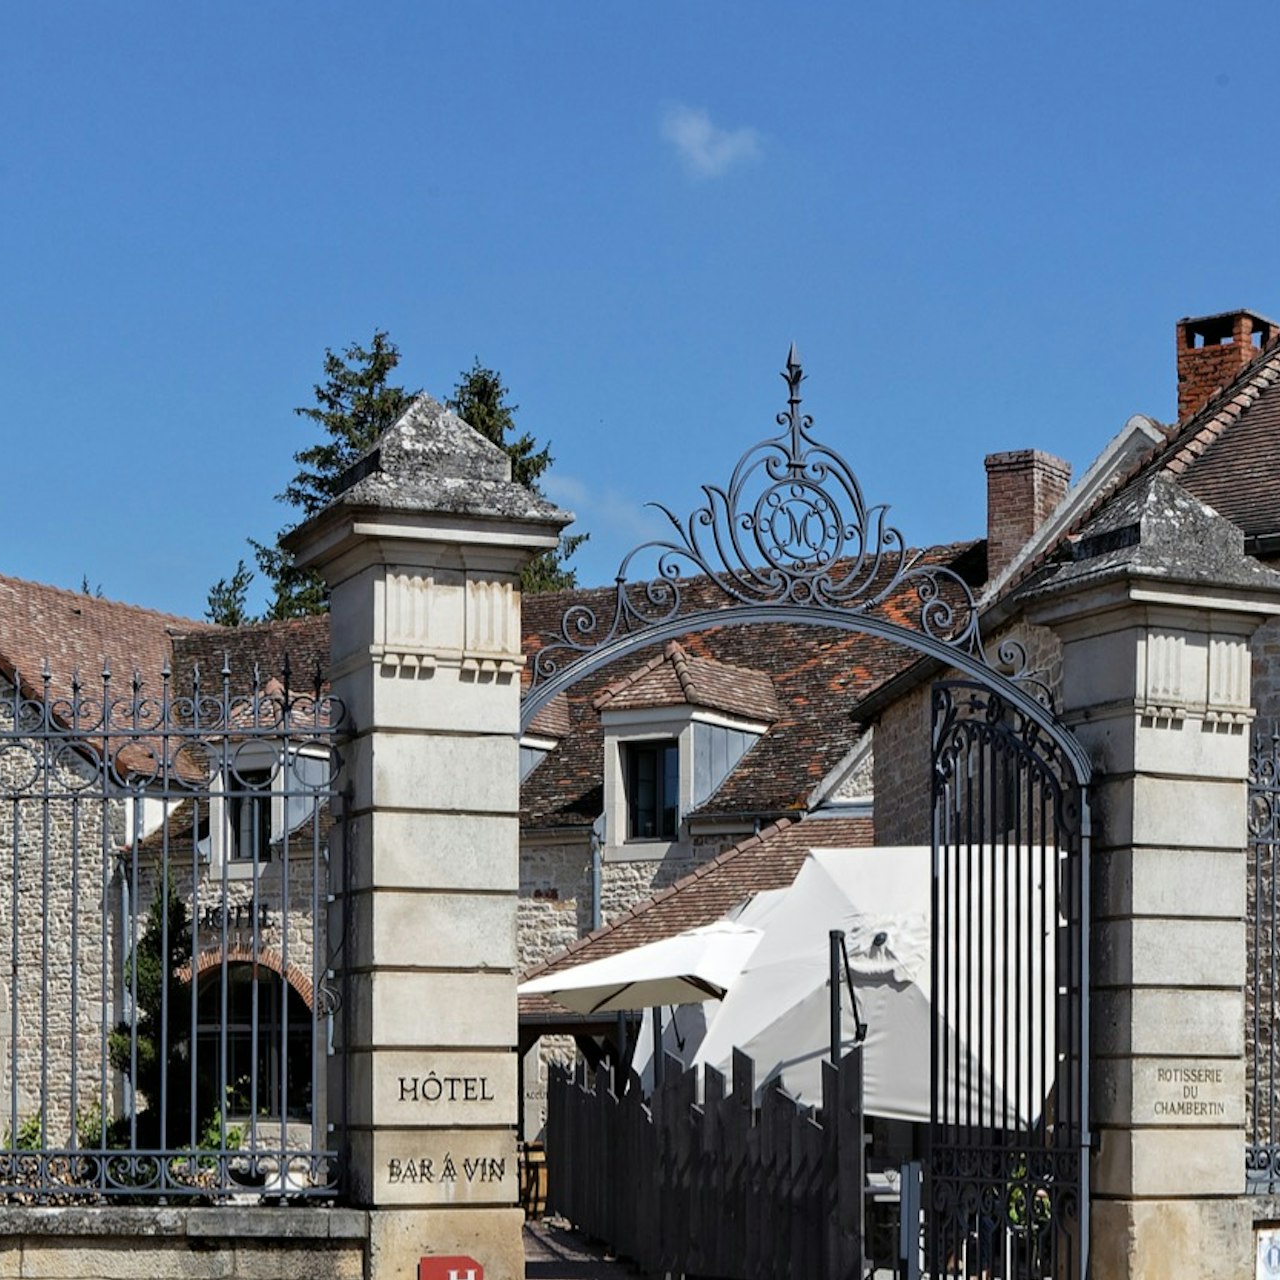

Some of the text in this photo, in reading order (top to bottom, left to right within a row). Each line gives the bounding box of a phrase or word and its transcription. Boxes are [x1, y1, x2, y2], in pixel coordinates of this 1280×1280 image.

[1157, 1068, 1223, 1083] ROTISSERIE
[397, 1070, 495, 1101] HÔTEL
[1183, 1085, 1199, 1099] DU
[1154, 1101, 1225, 1116] CHAMBERTIN
[387, 1157, 434, 1184] BAR
[462, 1157, 506, 1183] VIN
